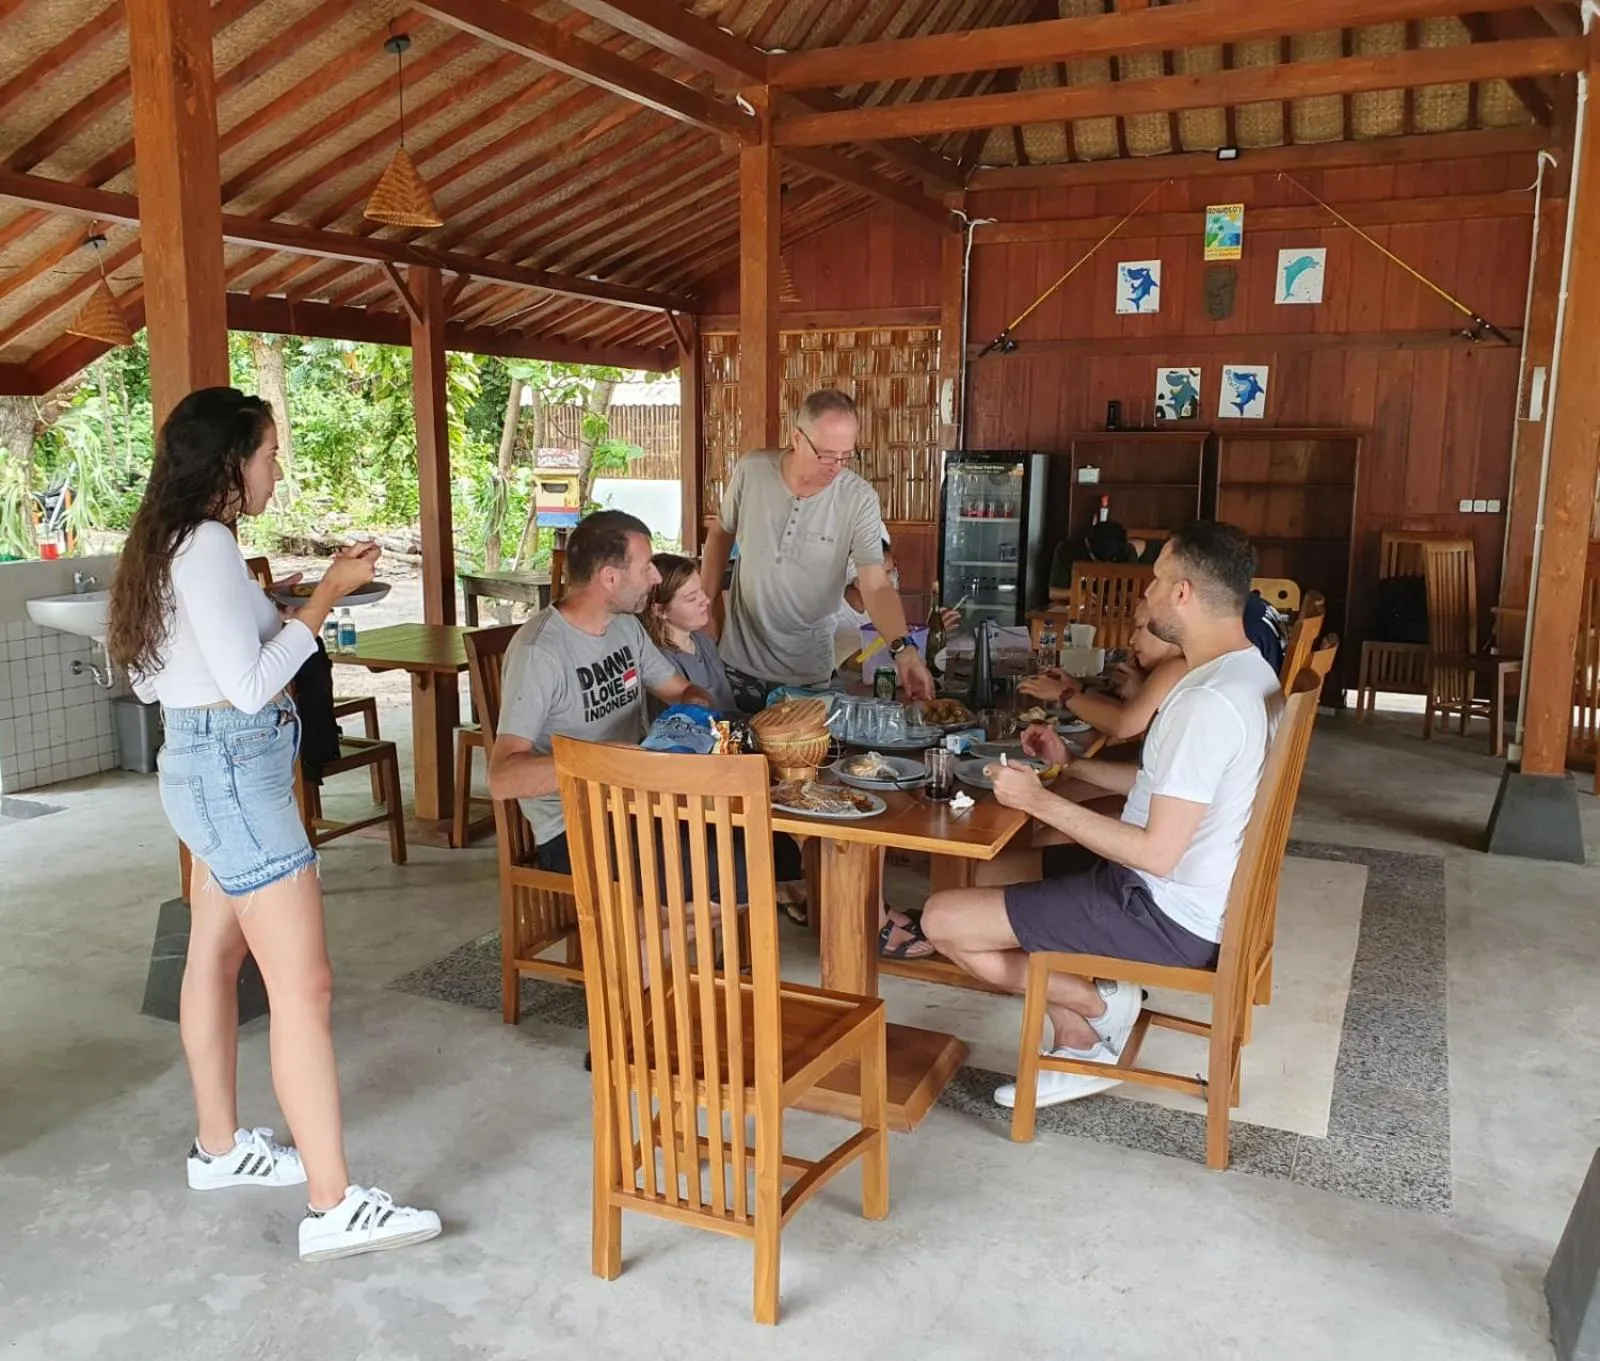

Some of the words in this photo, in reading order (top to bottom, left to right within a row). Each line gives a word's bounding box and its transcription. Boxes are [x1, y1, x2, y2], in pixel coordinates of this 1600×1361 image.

[576, 645, 635, 691] DAMN!
[582, 692, 590, 709] I
[590, 677, 625, 707] LOVE
